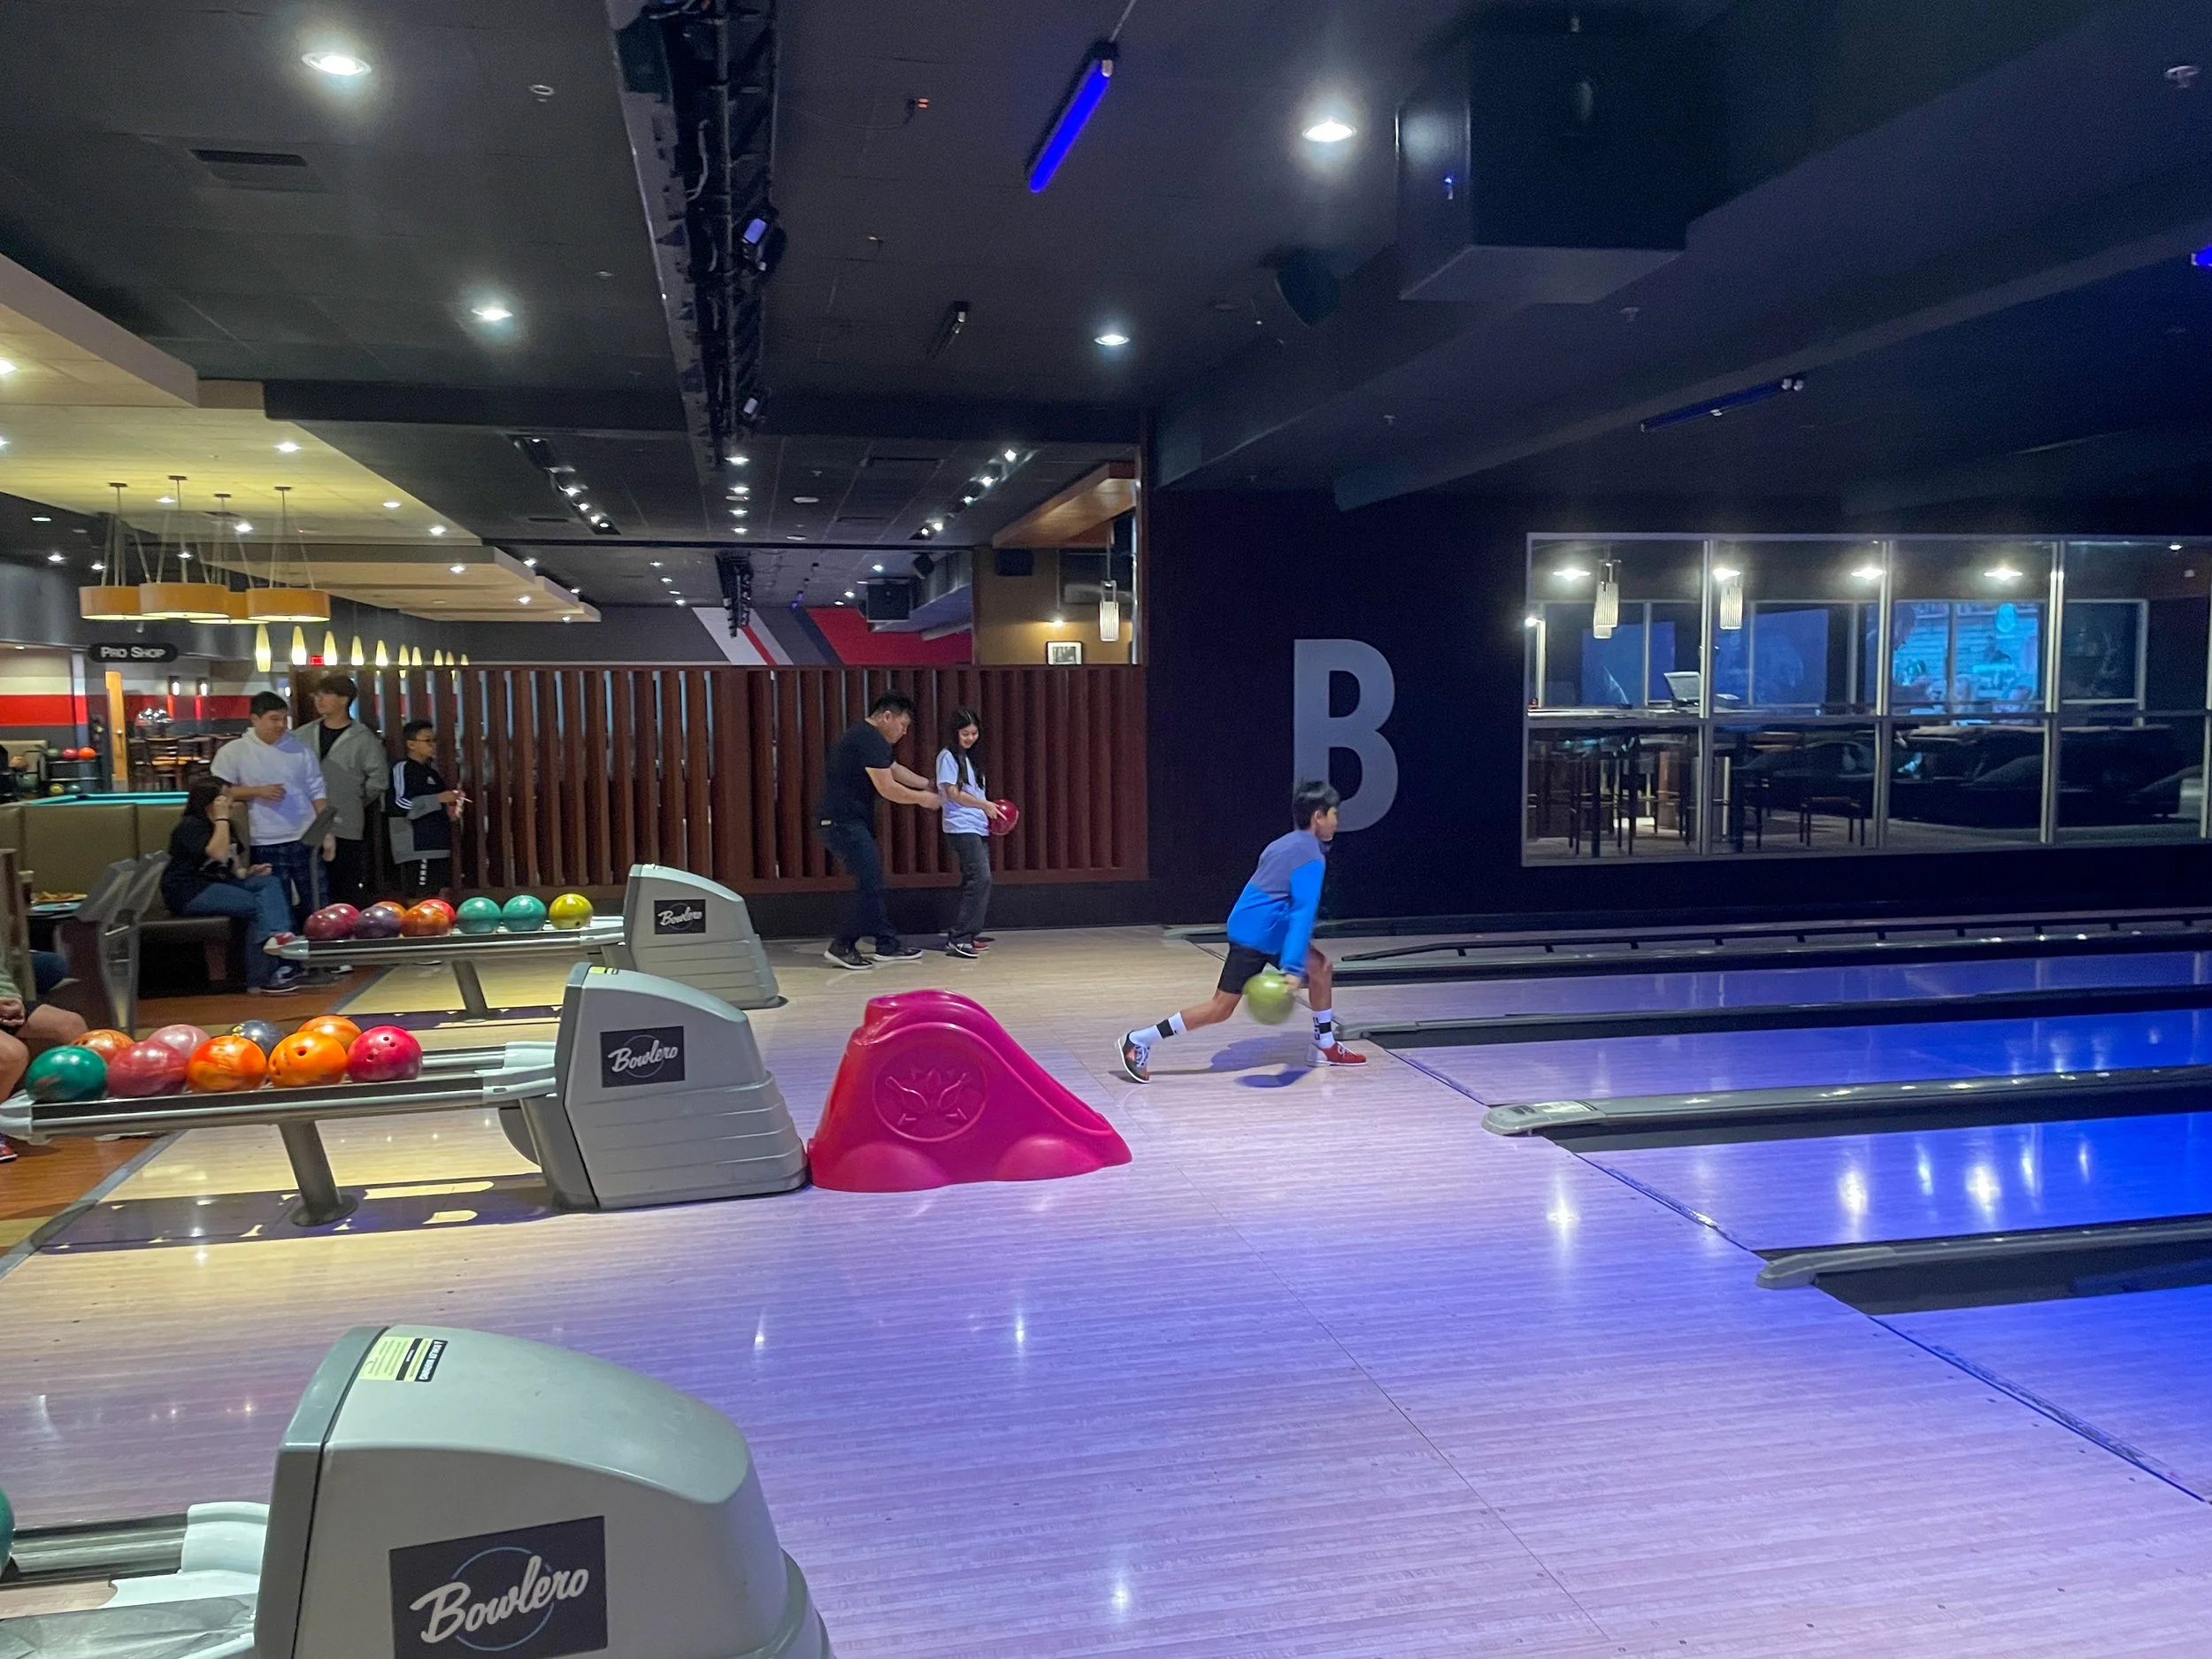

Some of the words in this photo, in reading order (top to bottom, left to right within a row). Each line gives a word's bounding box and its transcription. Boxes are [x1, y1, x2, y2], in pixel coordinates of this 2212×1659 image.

[1294, 638, 1400, 833] B
[657, 906, 703, 926] Bowlero
[607, 1039, 679, 1072] Bowlero
[409, 1555, 590, 1644] Bowlero
